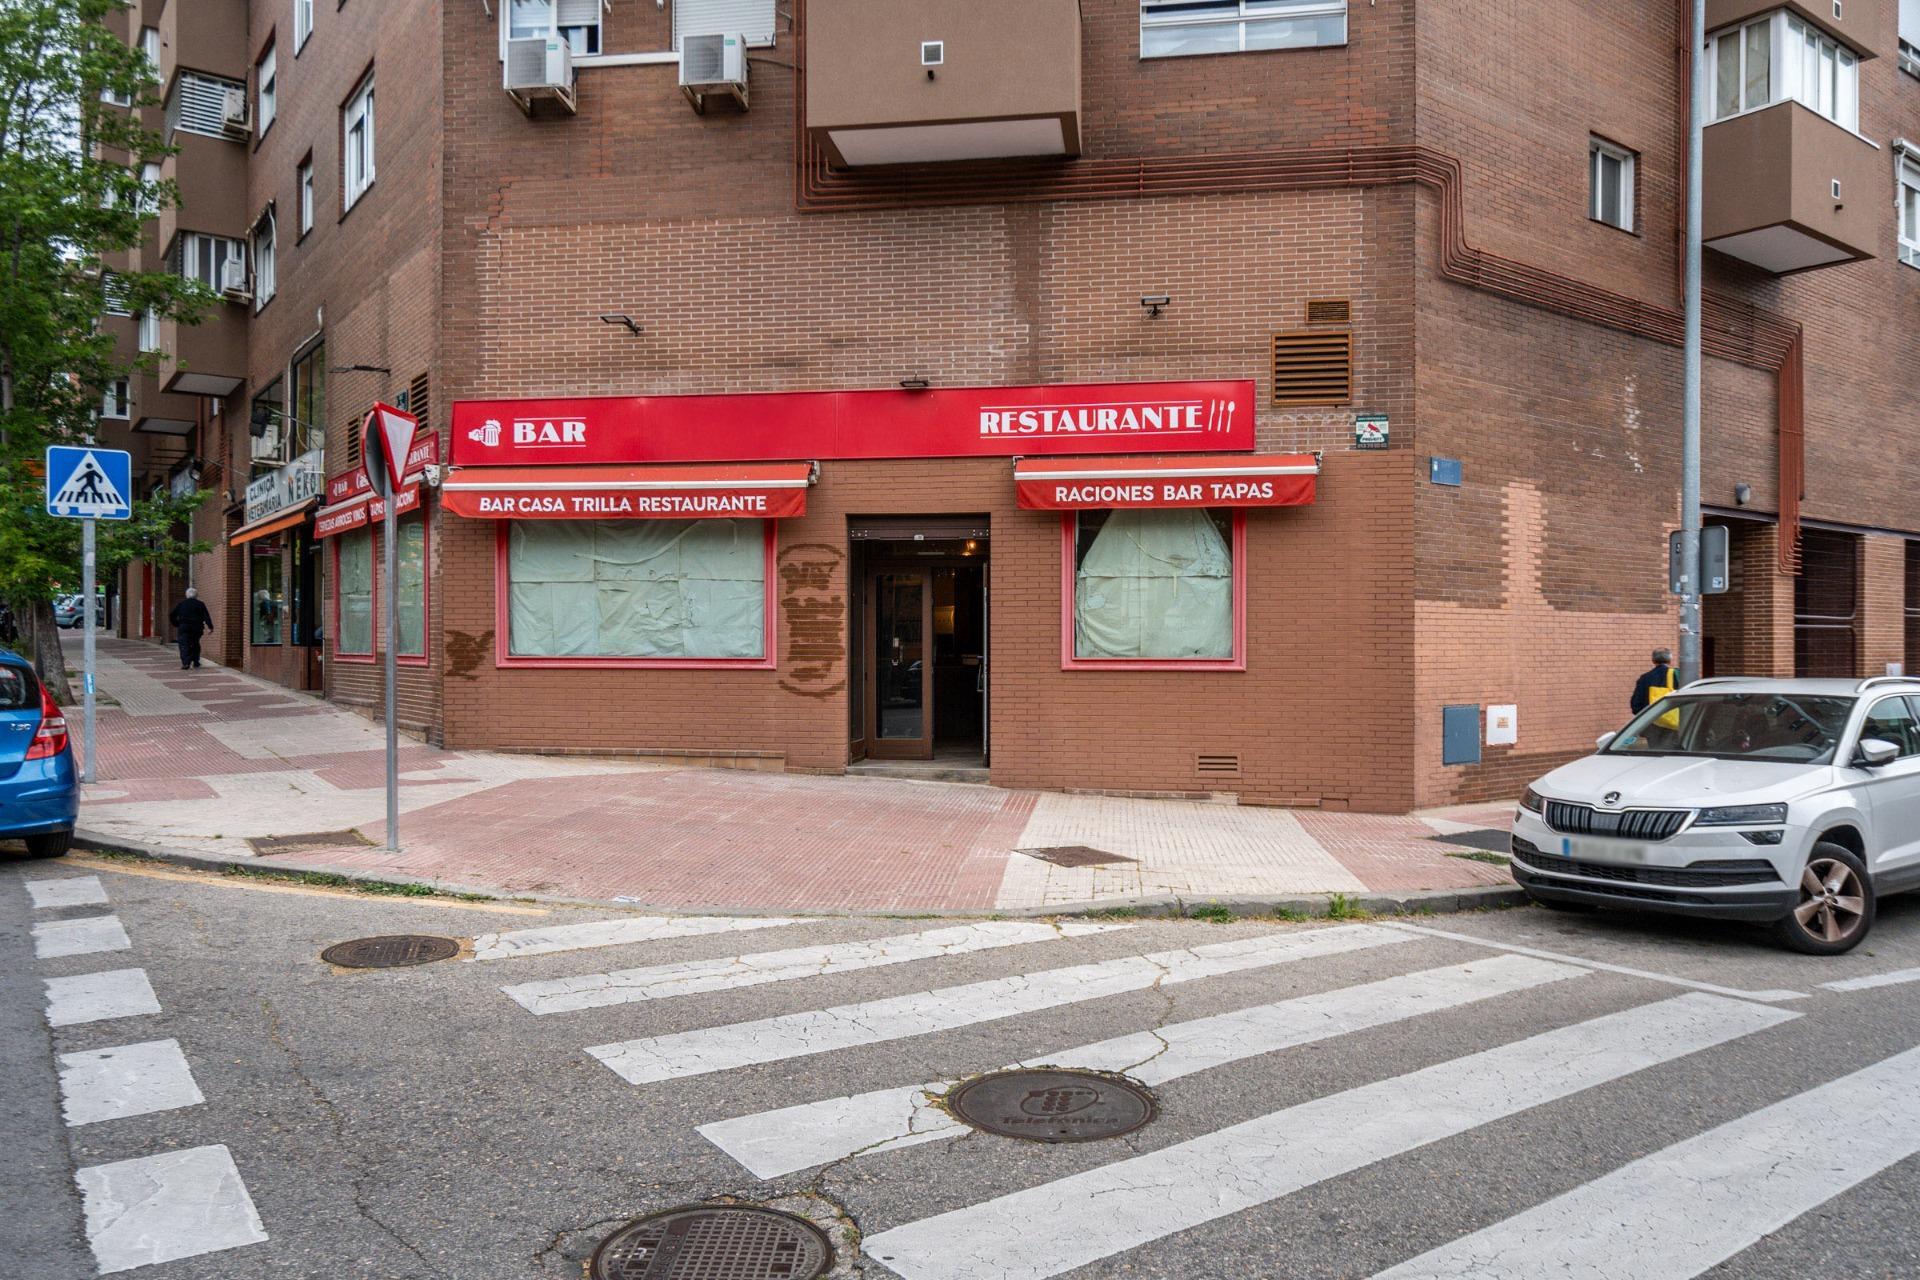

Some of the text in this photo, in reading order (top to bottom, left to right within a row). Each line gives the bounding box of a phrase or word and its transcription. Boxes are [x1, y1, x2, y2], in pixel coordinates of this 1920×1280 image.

[980, 406, 1203, 434] RESTAURANTE
[513, 422, 586, 443] BAR
[1055, 482, 1274, 502] RACIONES BAR TAPAS
[480, 495, 767, 512] BAR CASA TRILLA RESTAURANTE
